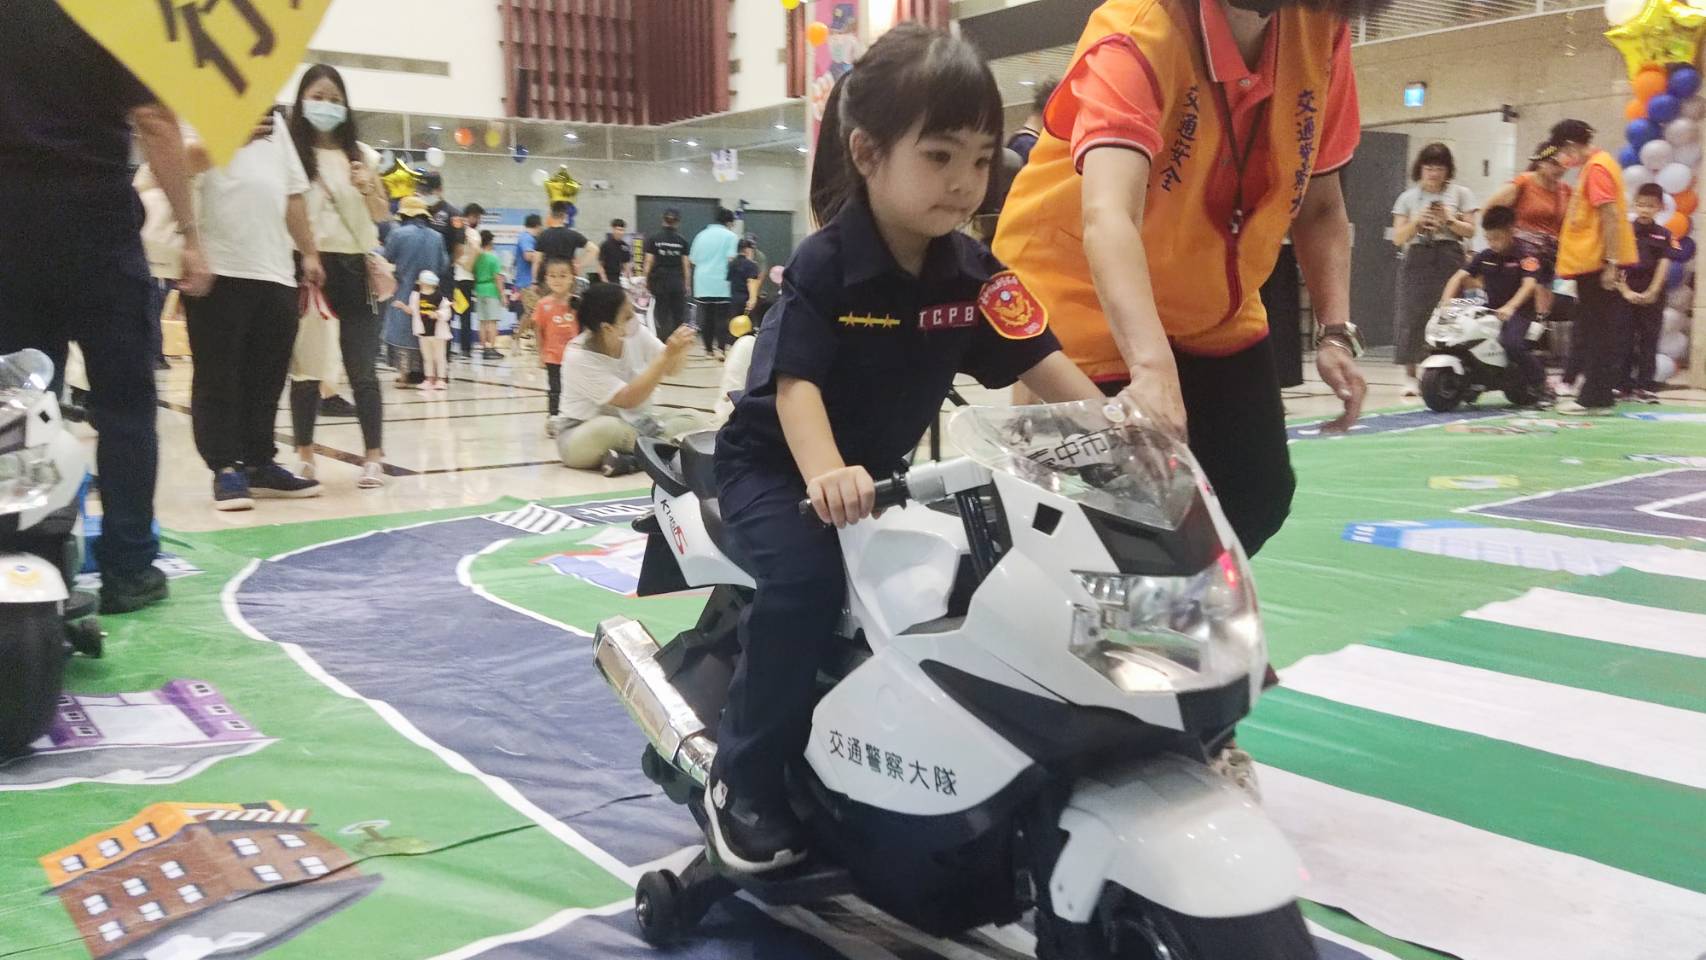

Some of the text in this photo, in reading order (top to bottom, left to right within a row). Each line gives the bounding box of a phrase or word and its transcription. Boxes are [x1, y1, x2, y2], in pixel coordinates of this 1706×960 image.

[157, 0, 300, 95] 行
[919, 306, 975, 328] TCPB
[829, 728, 957, 796] 交通警察大隊
